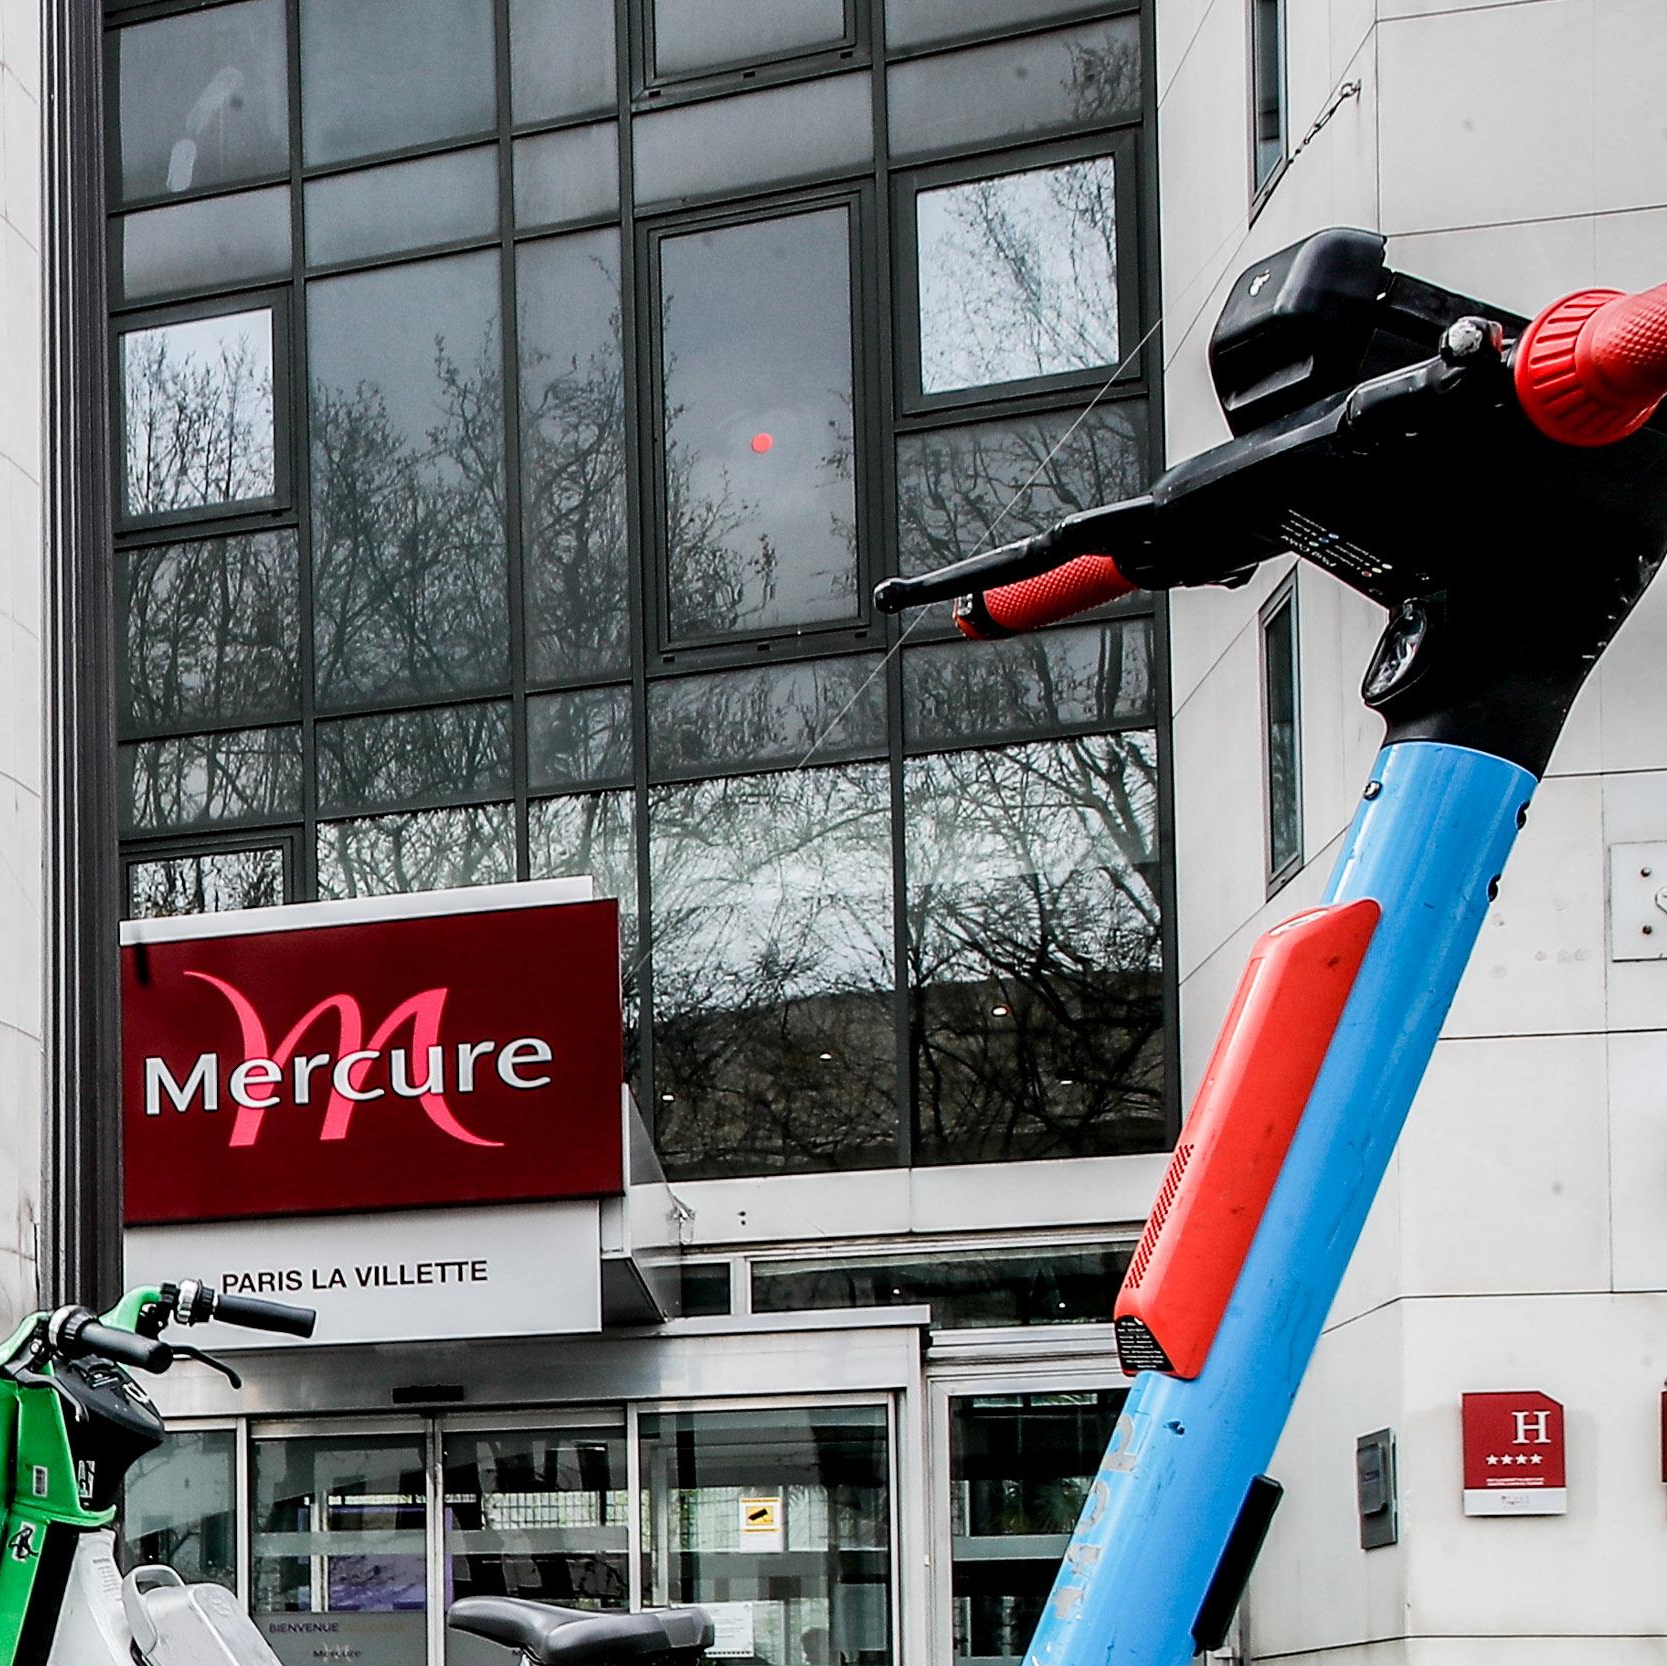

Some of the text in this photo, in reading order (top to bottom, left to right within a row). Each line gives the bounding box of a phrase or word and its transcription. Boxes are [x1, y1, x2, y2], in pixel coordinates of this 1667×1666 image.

[145, 1037, 553, 1116] Mercure
[222, 1260, 488, 1294] PARIS LA VILLETTE
[1511, 1410, 1551, 1444] H
[269, 1622, 339, 1634] BIENVENUE
